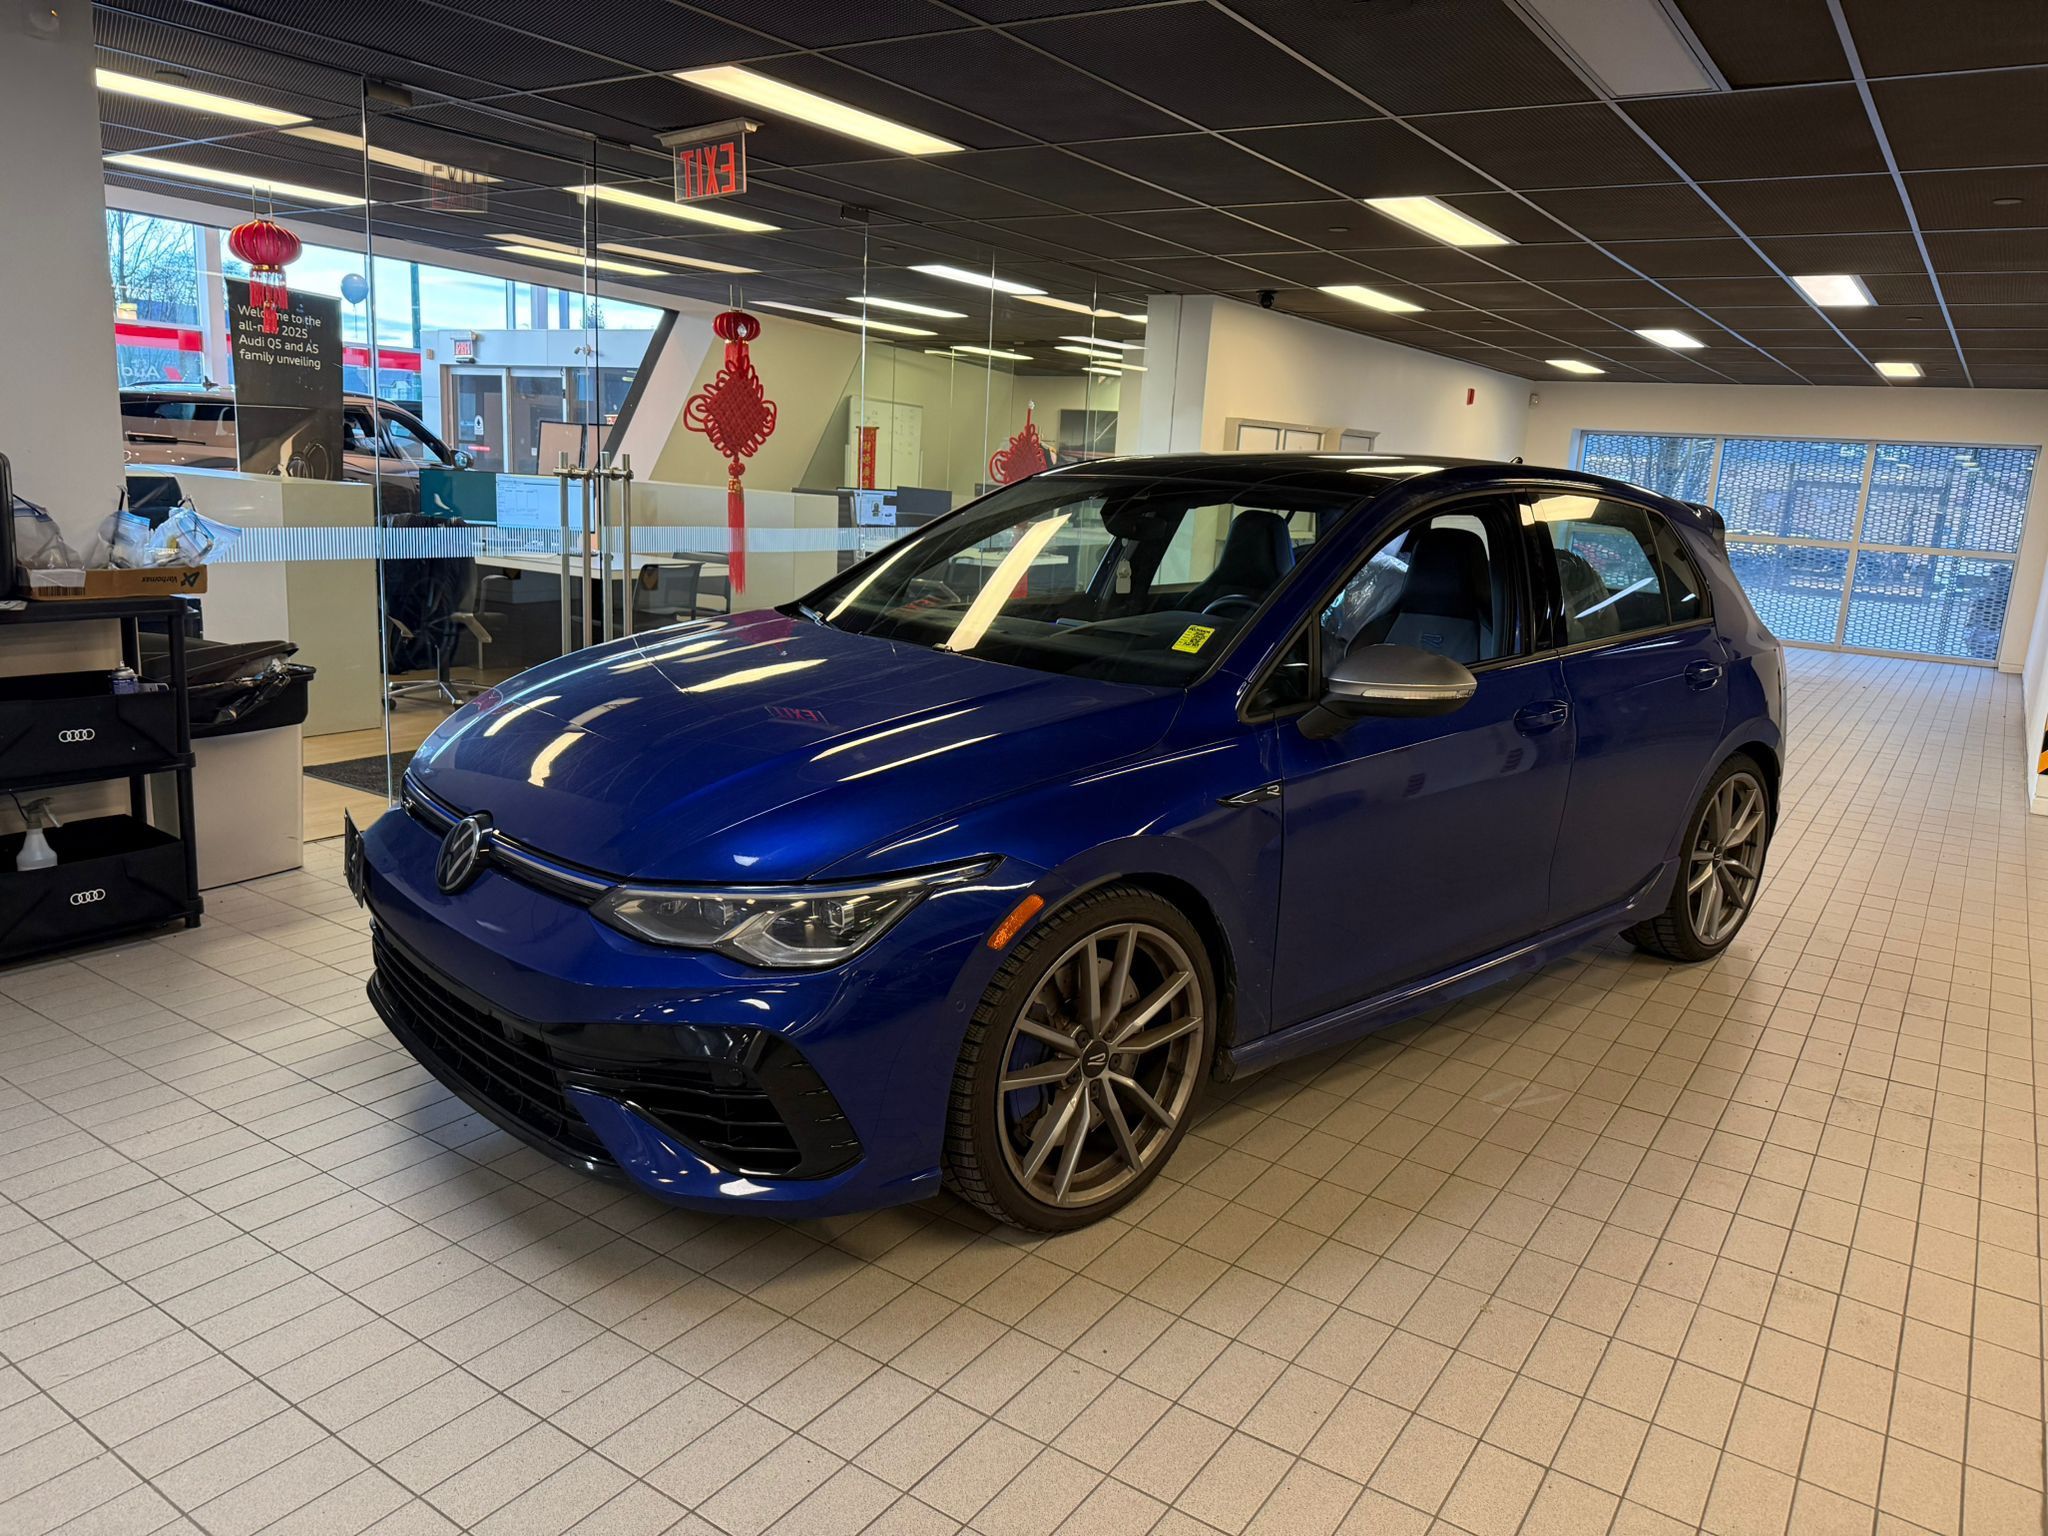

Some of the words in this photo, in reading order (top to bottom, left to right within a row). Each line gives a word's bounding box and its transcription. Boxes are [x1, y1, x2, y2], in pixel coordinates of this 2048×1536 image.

[237, 304, 289, 322] Welcme
[291, 313, 303, 324] to
[304, 315, 321, 327] the
[238, 320, 279, 334] all-n
[282, 326, 308, 339] 2025
[238, 334, 265, 347] Audi
[267, 338, 282, 350] Q5
[284, 341, 304, 352] and
[305, 343, 319, 354] A5
[239, 349, 275, 365] family
[276, 355, 321, 371] unveiling
